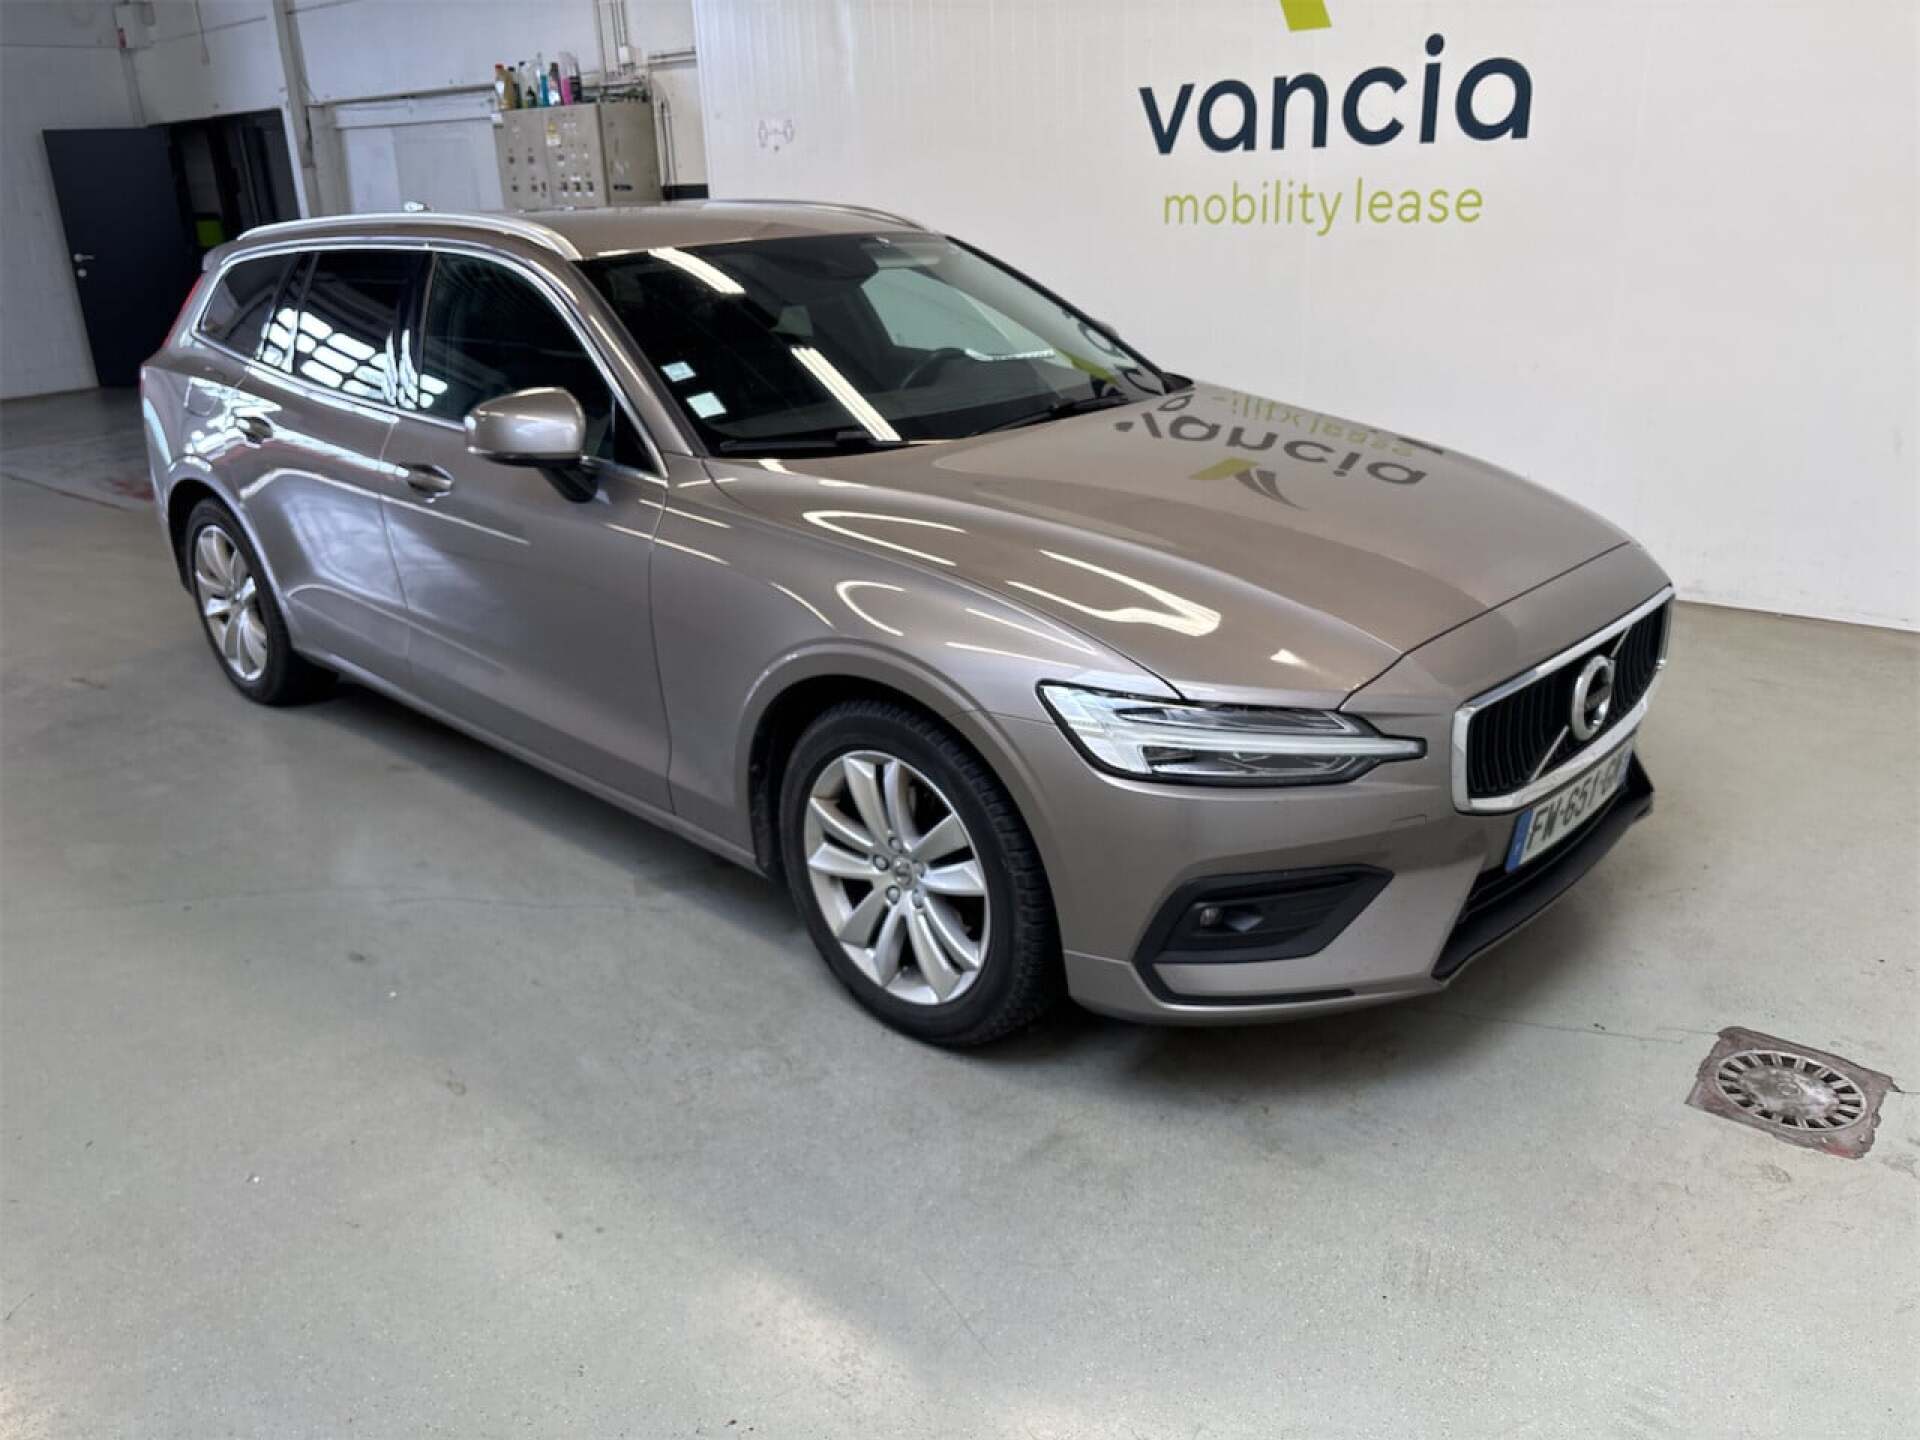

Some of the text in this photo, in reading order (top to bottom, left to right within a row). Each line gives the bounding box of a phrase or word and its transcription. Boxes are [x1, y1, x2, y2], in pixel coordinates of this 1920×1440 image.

[1139, 34, 1532, 154] vancia
[1163, 177, 1484, 236] mobility lease
